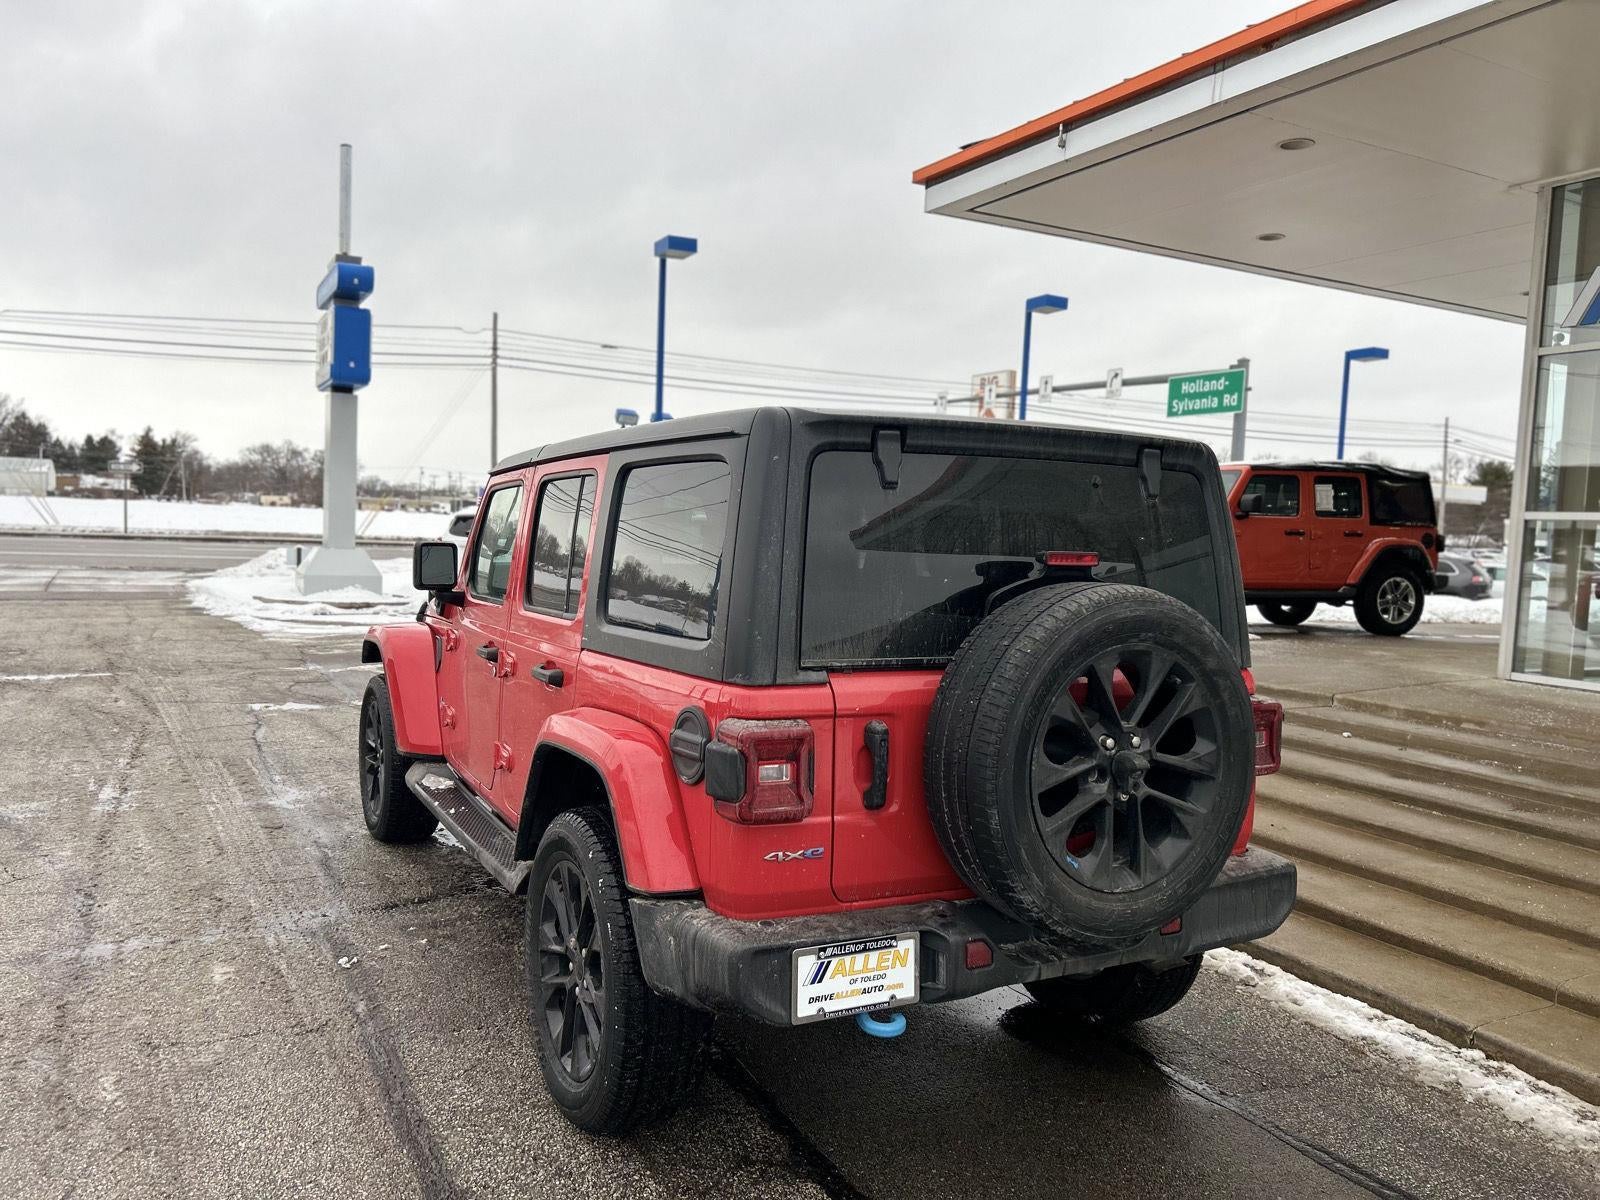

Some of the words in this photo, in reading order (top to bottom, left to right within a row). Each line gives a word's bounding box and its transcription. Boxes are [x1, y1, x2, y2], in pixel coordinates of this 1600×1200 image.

[1181, 377, 1229, 394] Holland-
[1172, 397, 1218, 414] Sylvania
[1223, 393, 1238, 407] Rd
[832, 944, 856, 956] ALLEN
[856, 943, 865, 951] OF
[866, 939, 891, 950] TOLEDO
[829, 948, 909, 980] ALLEN
[849, 977, 859, 985] OF
[860, 973, 887, 984] TOLEDO
